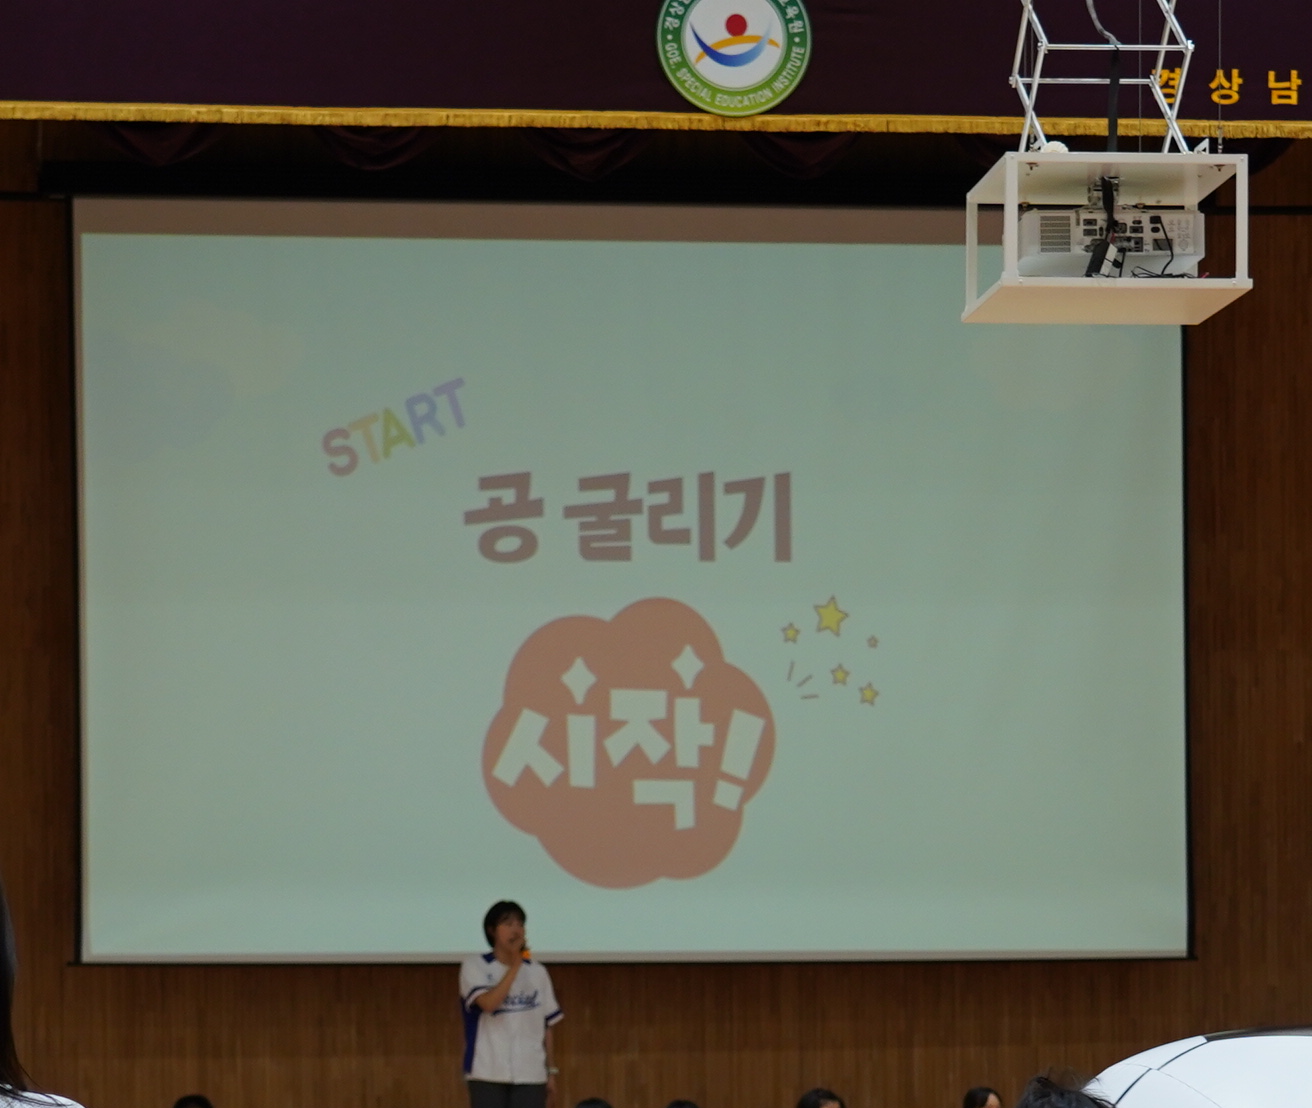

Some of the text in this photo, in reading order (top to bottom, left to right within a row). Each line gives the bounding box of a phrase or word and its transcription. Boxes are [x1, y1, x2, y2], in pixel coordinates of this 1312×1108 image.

[676, 68, 712, 101] SPECIAL
[715, 89, 773, 107] EDUCATION
[771, 46, 805, 92] INSTITUTE
[321, 377, 467, 477] START
[463, 471, 793, 564] 공 굴리기
[491, 688, 766, 831] 시작!
